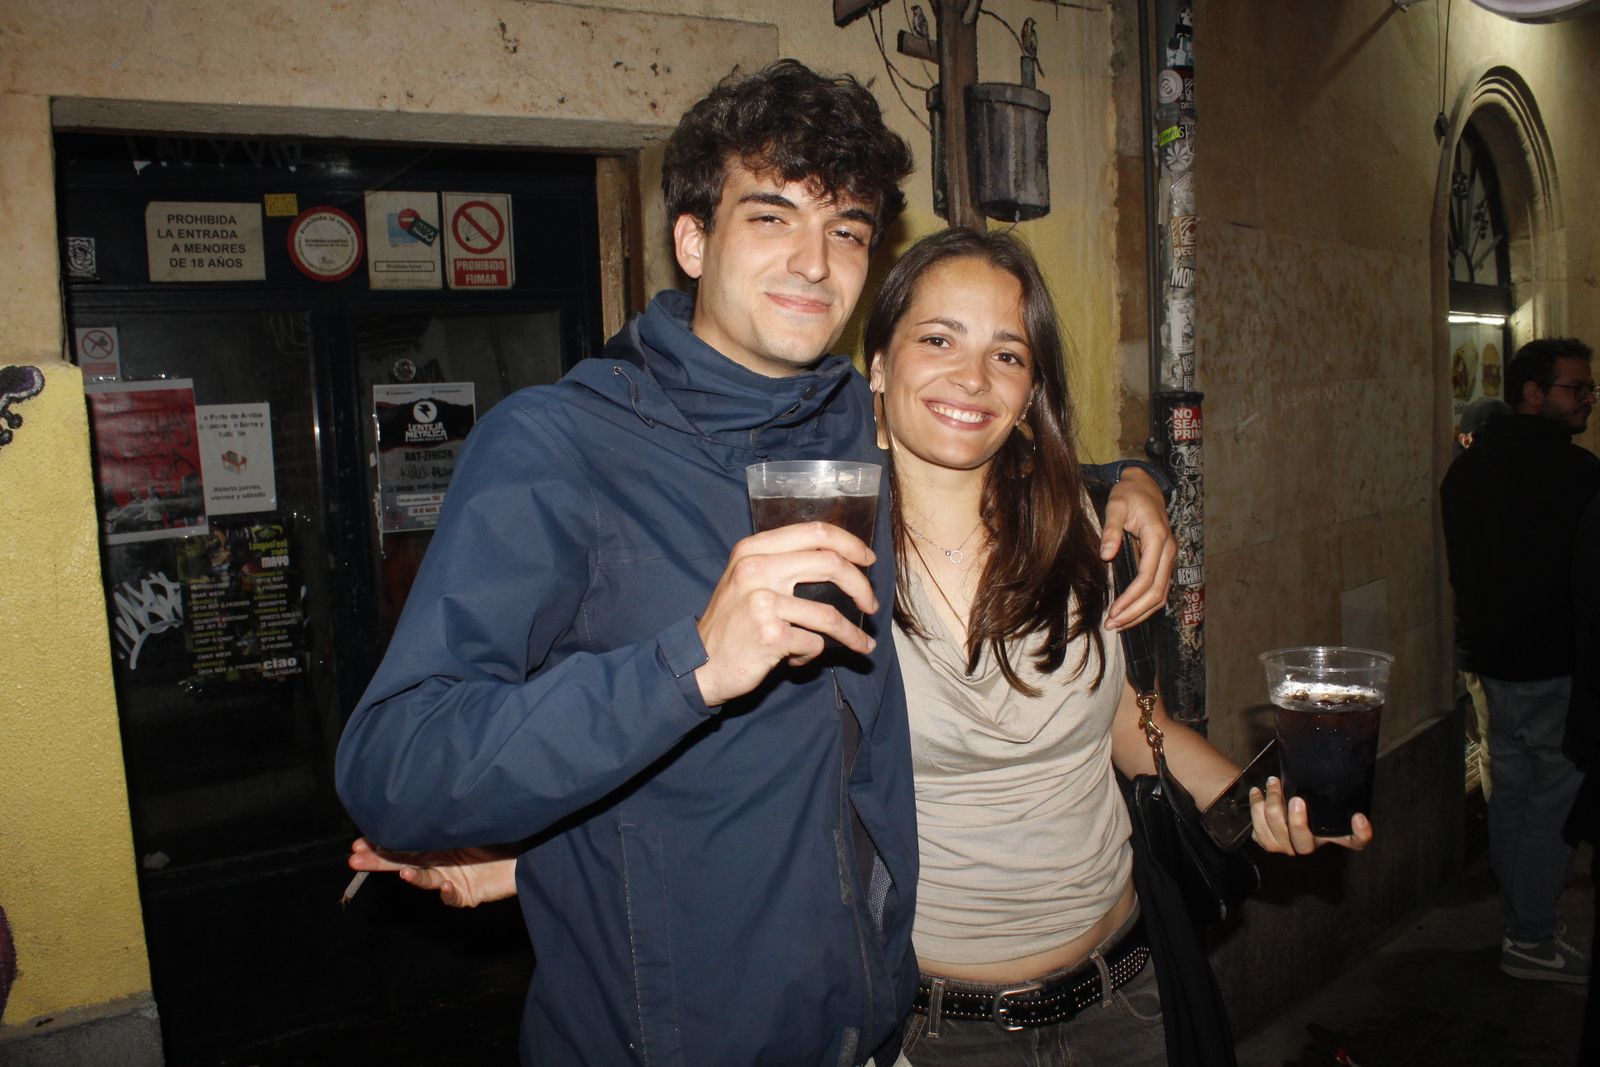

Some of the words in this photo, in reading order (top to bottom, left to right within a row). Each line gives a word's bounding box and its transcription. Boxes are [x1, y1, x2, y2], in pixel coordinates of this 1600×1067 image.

[166, 213, 237, 225] PROHIBIDA
[157, 228, 174, 239] LA
[178, 228, 238, 239] ENTRADA
[171, 243, 181, 254] A
[184, 243, 246, 254] MENORES
[169, 257, 188, 268] DE
[190, 257, 204, 268] 18
[208, 255, 243, 268] AÑOS
[456, 260, 505, 271] PROHIBIDO
[465, 274, 498, 284] FUMAR
[1173, 408, 1193, 419] NO
[408, 422, 444, 432] LENTEJA
[261, 555, 290, 568] MAYO
[263, 656, 297, 670] ciao
